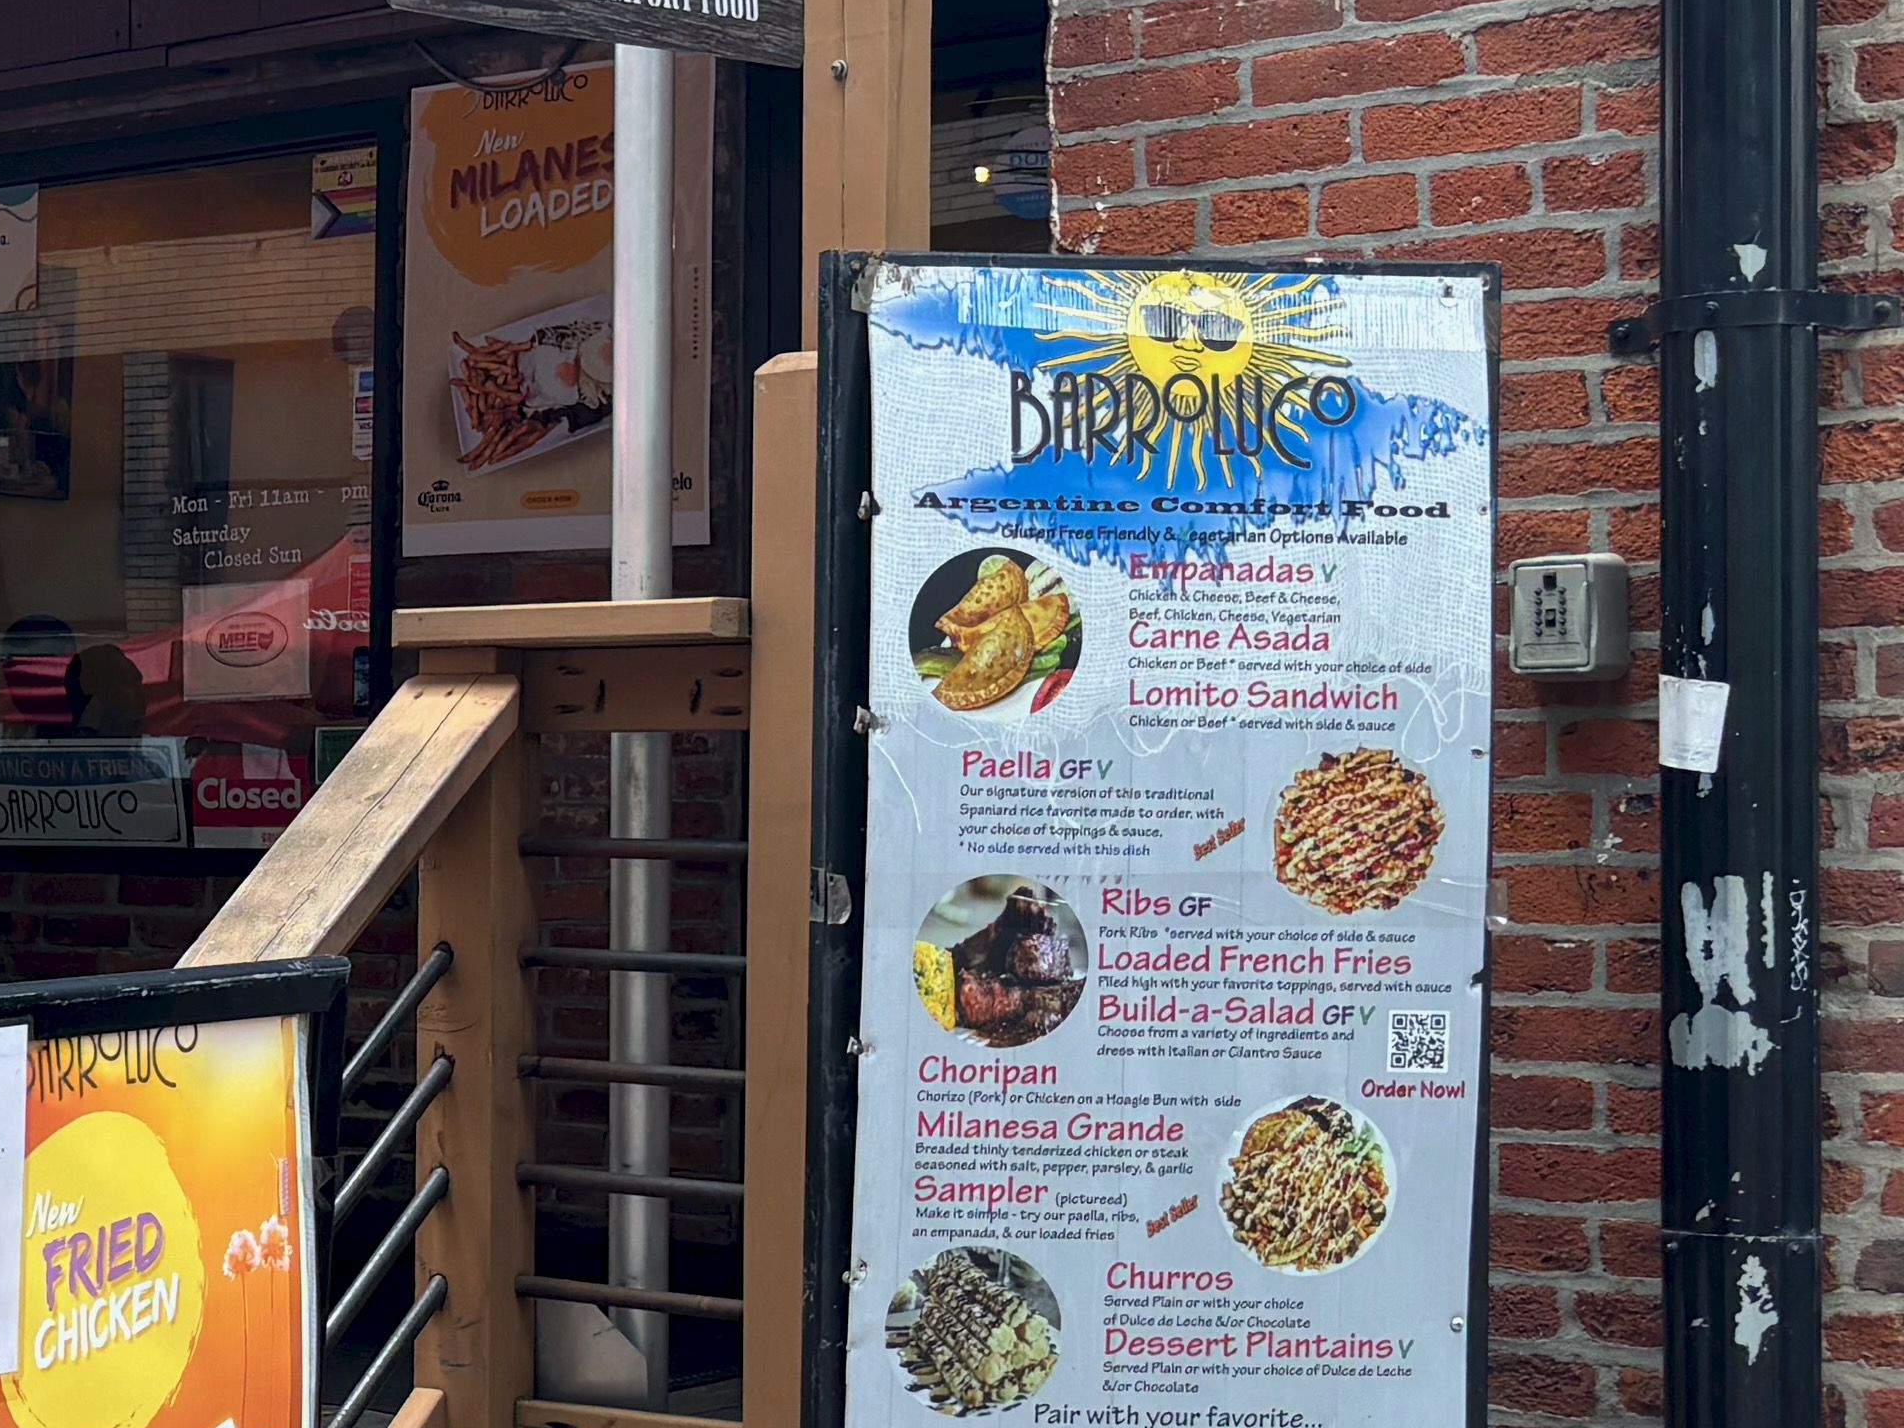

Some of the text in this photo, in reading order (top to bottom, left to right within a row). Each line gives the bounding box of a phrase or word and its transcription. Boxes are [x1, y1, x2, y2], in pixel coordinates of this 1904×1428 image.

[474, 129, 525, 156] New
[450, 132, 615, 208] MILANES
[480, 180, 614, 238] LOADED
[1009, 372, 1357, 468] BARROLUCO
[172, 485, 368, 514] Mon Fri 11am pm
[418, 490, 461, 505] Corona
[914, 492, 1451, 520] Argentine Comfort Food
[173, 526, 251, 546] Saturday
[204, 547, 301, 568] Closed Sun
[1129, 553, 1314, 586] Empanadas
[1128, 589, 1177, 602] Chicken
[1247, 592, 1275, 604] Beef
[1128, 624, 1330, 653] Carne Asada
[1128, 682, 1398, 712] Lomito Sandwich
[961, 751, 1052, 780] Paella
[1059, 759, 1093, 779] GF
[197, 776, 301, 811] Closed
[960, 785, 1213, 805] Our signature version of this traditional
[1102, 888, 1211, 917] Ribs GF
[1098, 945, 1412, 975] Loaded French Fries
[1098, 995, 1314, 1026] Build-a-Salad
[1323, 1005, 1355, 1026] GF
[919, 1056, 1057, 1093] Choripan
[1361, 1080, 1465, 1099] Order Now!
[918, 1112, 1183, 1142] Milanesa Grande
[914, 1175, 1048, 1212] Sampler
[26, 1191, 84, 1237] New
[42, 1212, 165, 1312] FRIED
[1107, 1262, 1234, 1291] Churros
[33, 1274, 180, 1370] CHICKEN
[1105, 1329, 1237, 1357] Dessert
[1246, 1329, 1393, 1359] Plantains
[1033, 1404, 1081, 1424] Pair
[1085, 1405, 1140, 1426] with
